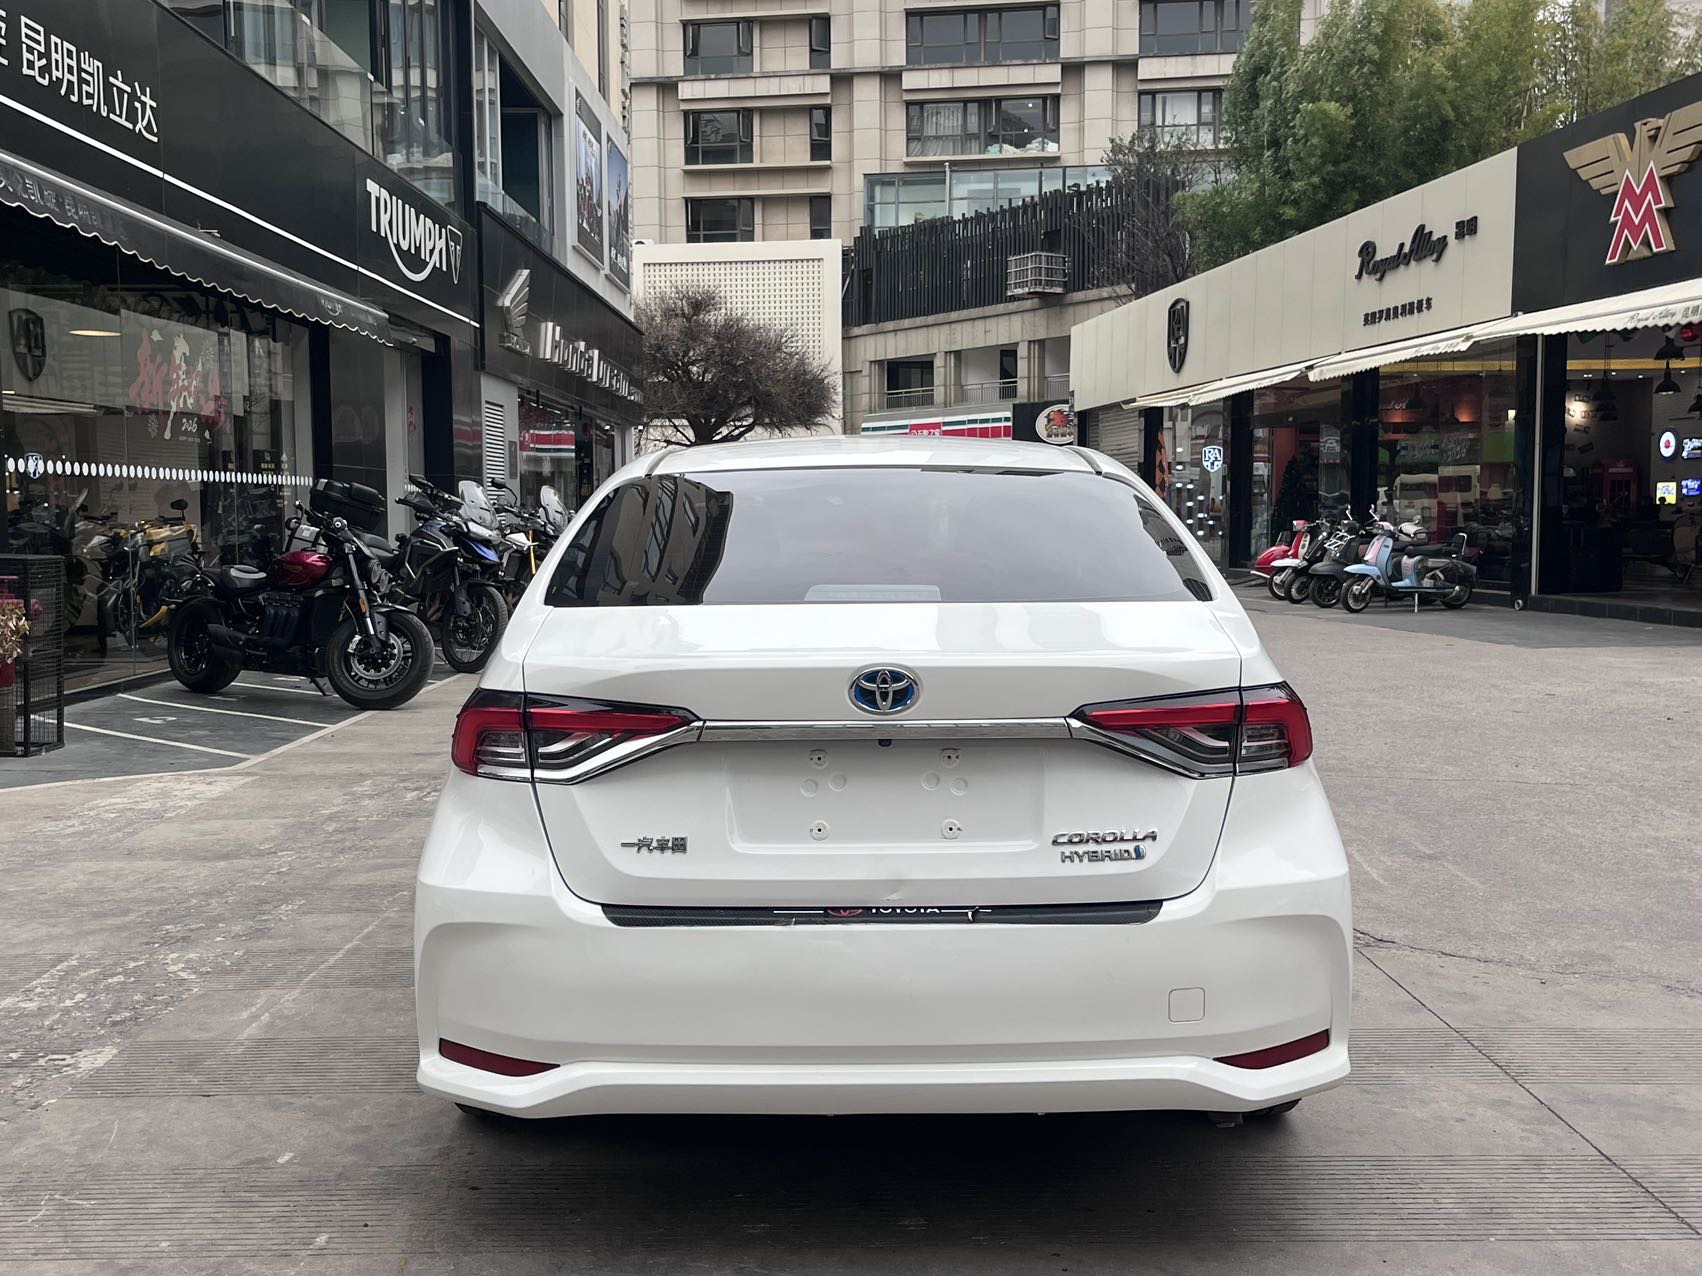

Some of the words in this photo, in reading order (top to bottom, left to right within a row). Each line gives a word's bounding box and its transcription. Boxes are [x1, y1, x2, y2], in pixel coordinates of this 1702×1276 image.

[20, 15, 158, 142] 昆明凯立达
[366, 178, 447, 282] TRIUMPH
[1052, 828, 1158, 846] COROLLA
[1060, 848, 1133, 863] HYBRID
